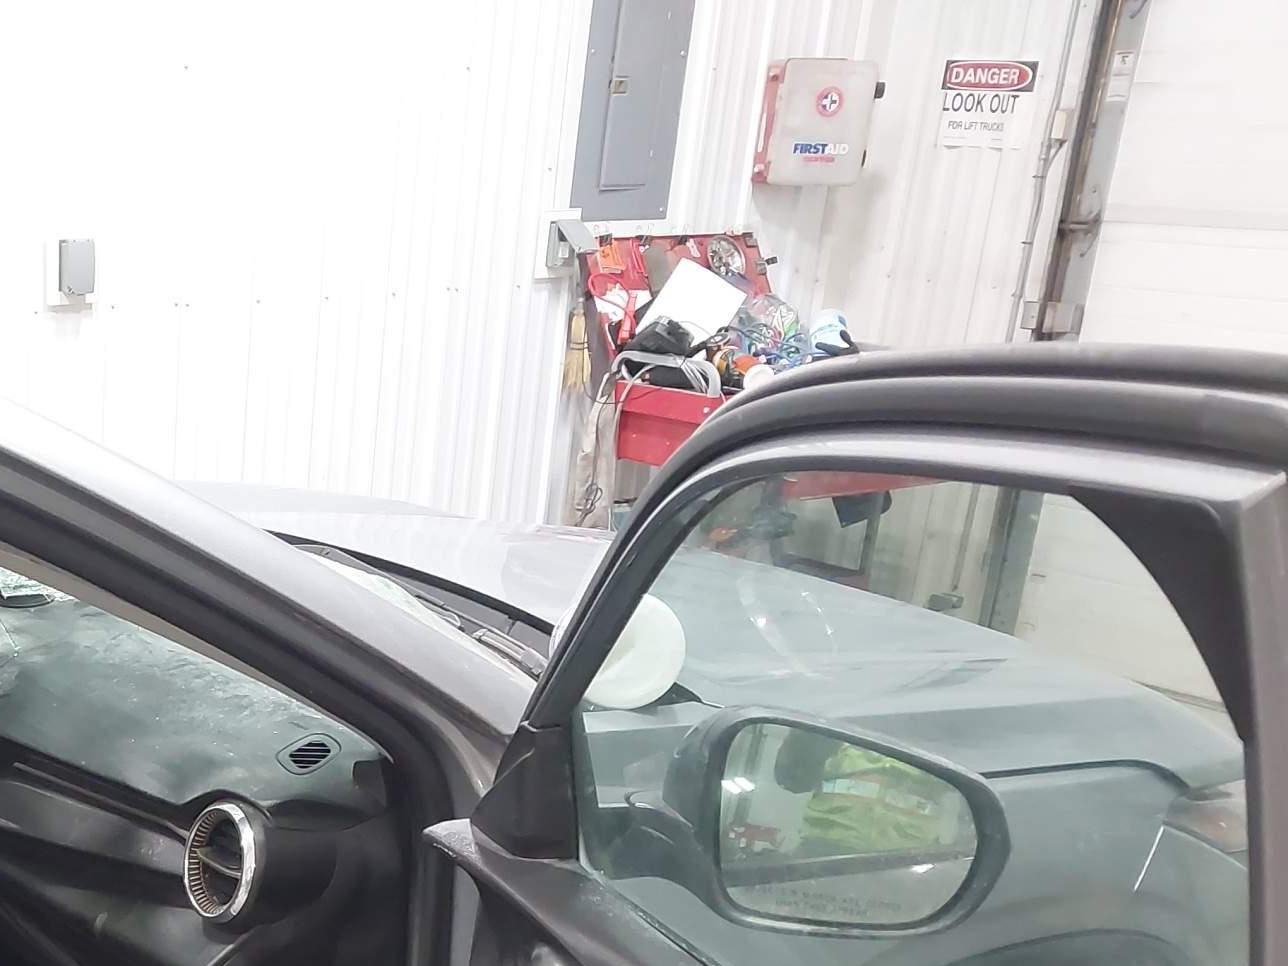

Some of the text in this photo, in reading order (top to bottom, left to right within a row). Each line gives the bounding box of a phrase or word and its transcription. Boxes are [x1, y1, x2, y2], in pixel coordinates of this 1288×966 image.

[950, 67, 1020, 85] DANGER
[942, 92, 1020, 114] LOOK OUT
[964, 121, 978, 131] LIFT
[979, 121, 1005, 132] TRUCKS
